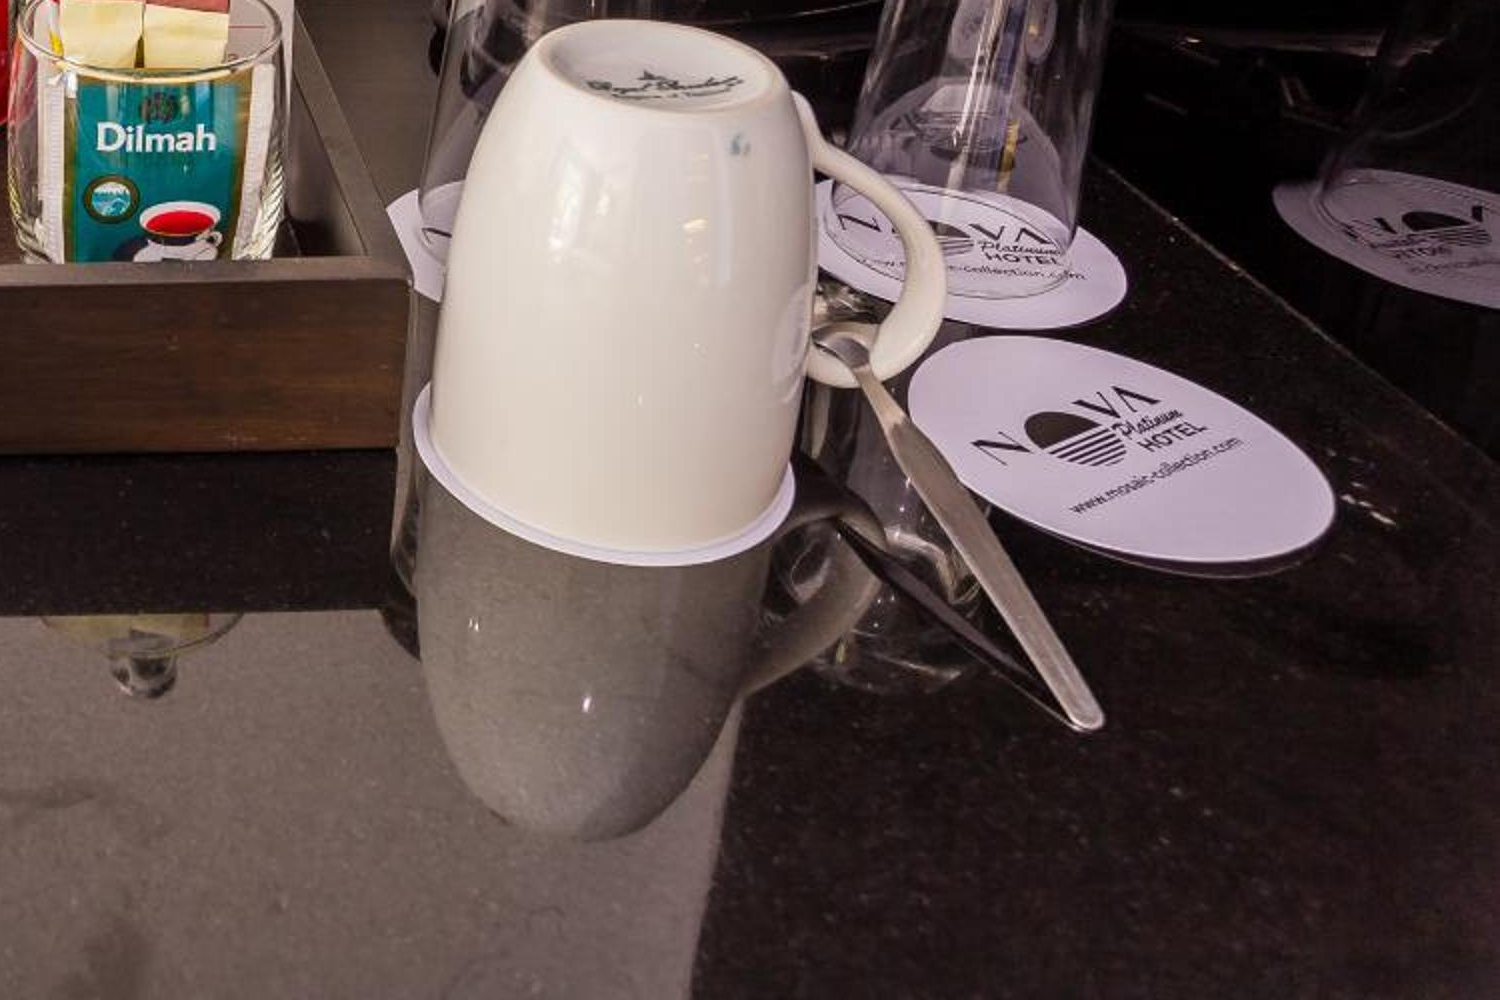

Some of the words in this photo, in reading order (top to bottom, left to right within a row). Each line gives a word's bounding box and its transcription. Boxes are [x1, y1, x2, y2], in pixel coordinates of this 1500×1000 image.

[96, 121, 218, 153] Dilmah
[984, 252, 1065, 267] HOTEL
[970, 384, 1162, 467] NOVA
[1111, 408, 1184, 440] Platinum
[1137, 421, 1209, 454] HOTEL
[1069, 435, 1245, 516] www.mosaic-collection.com
